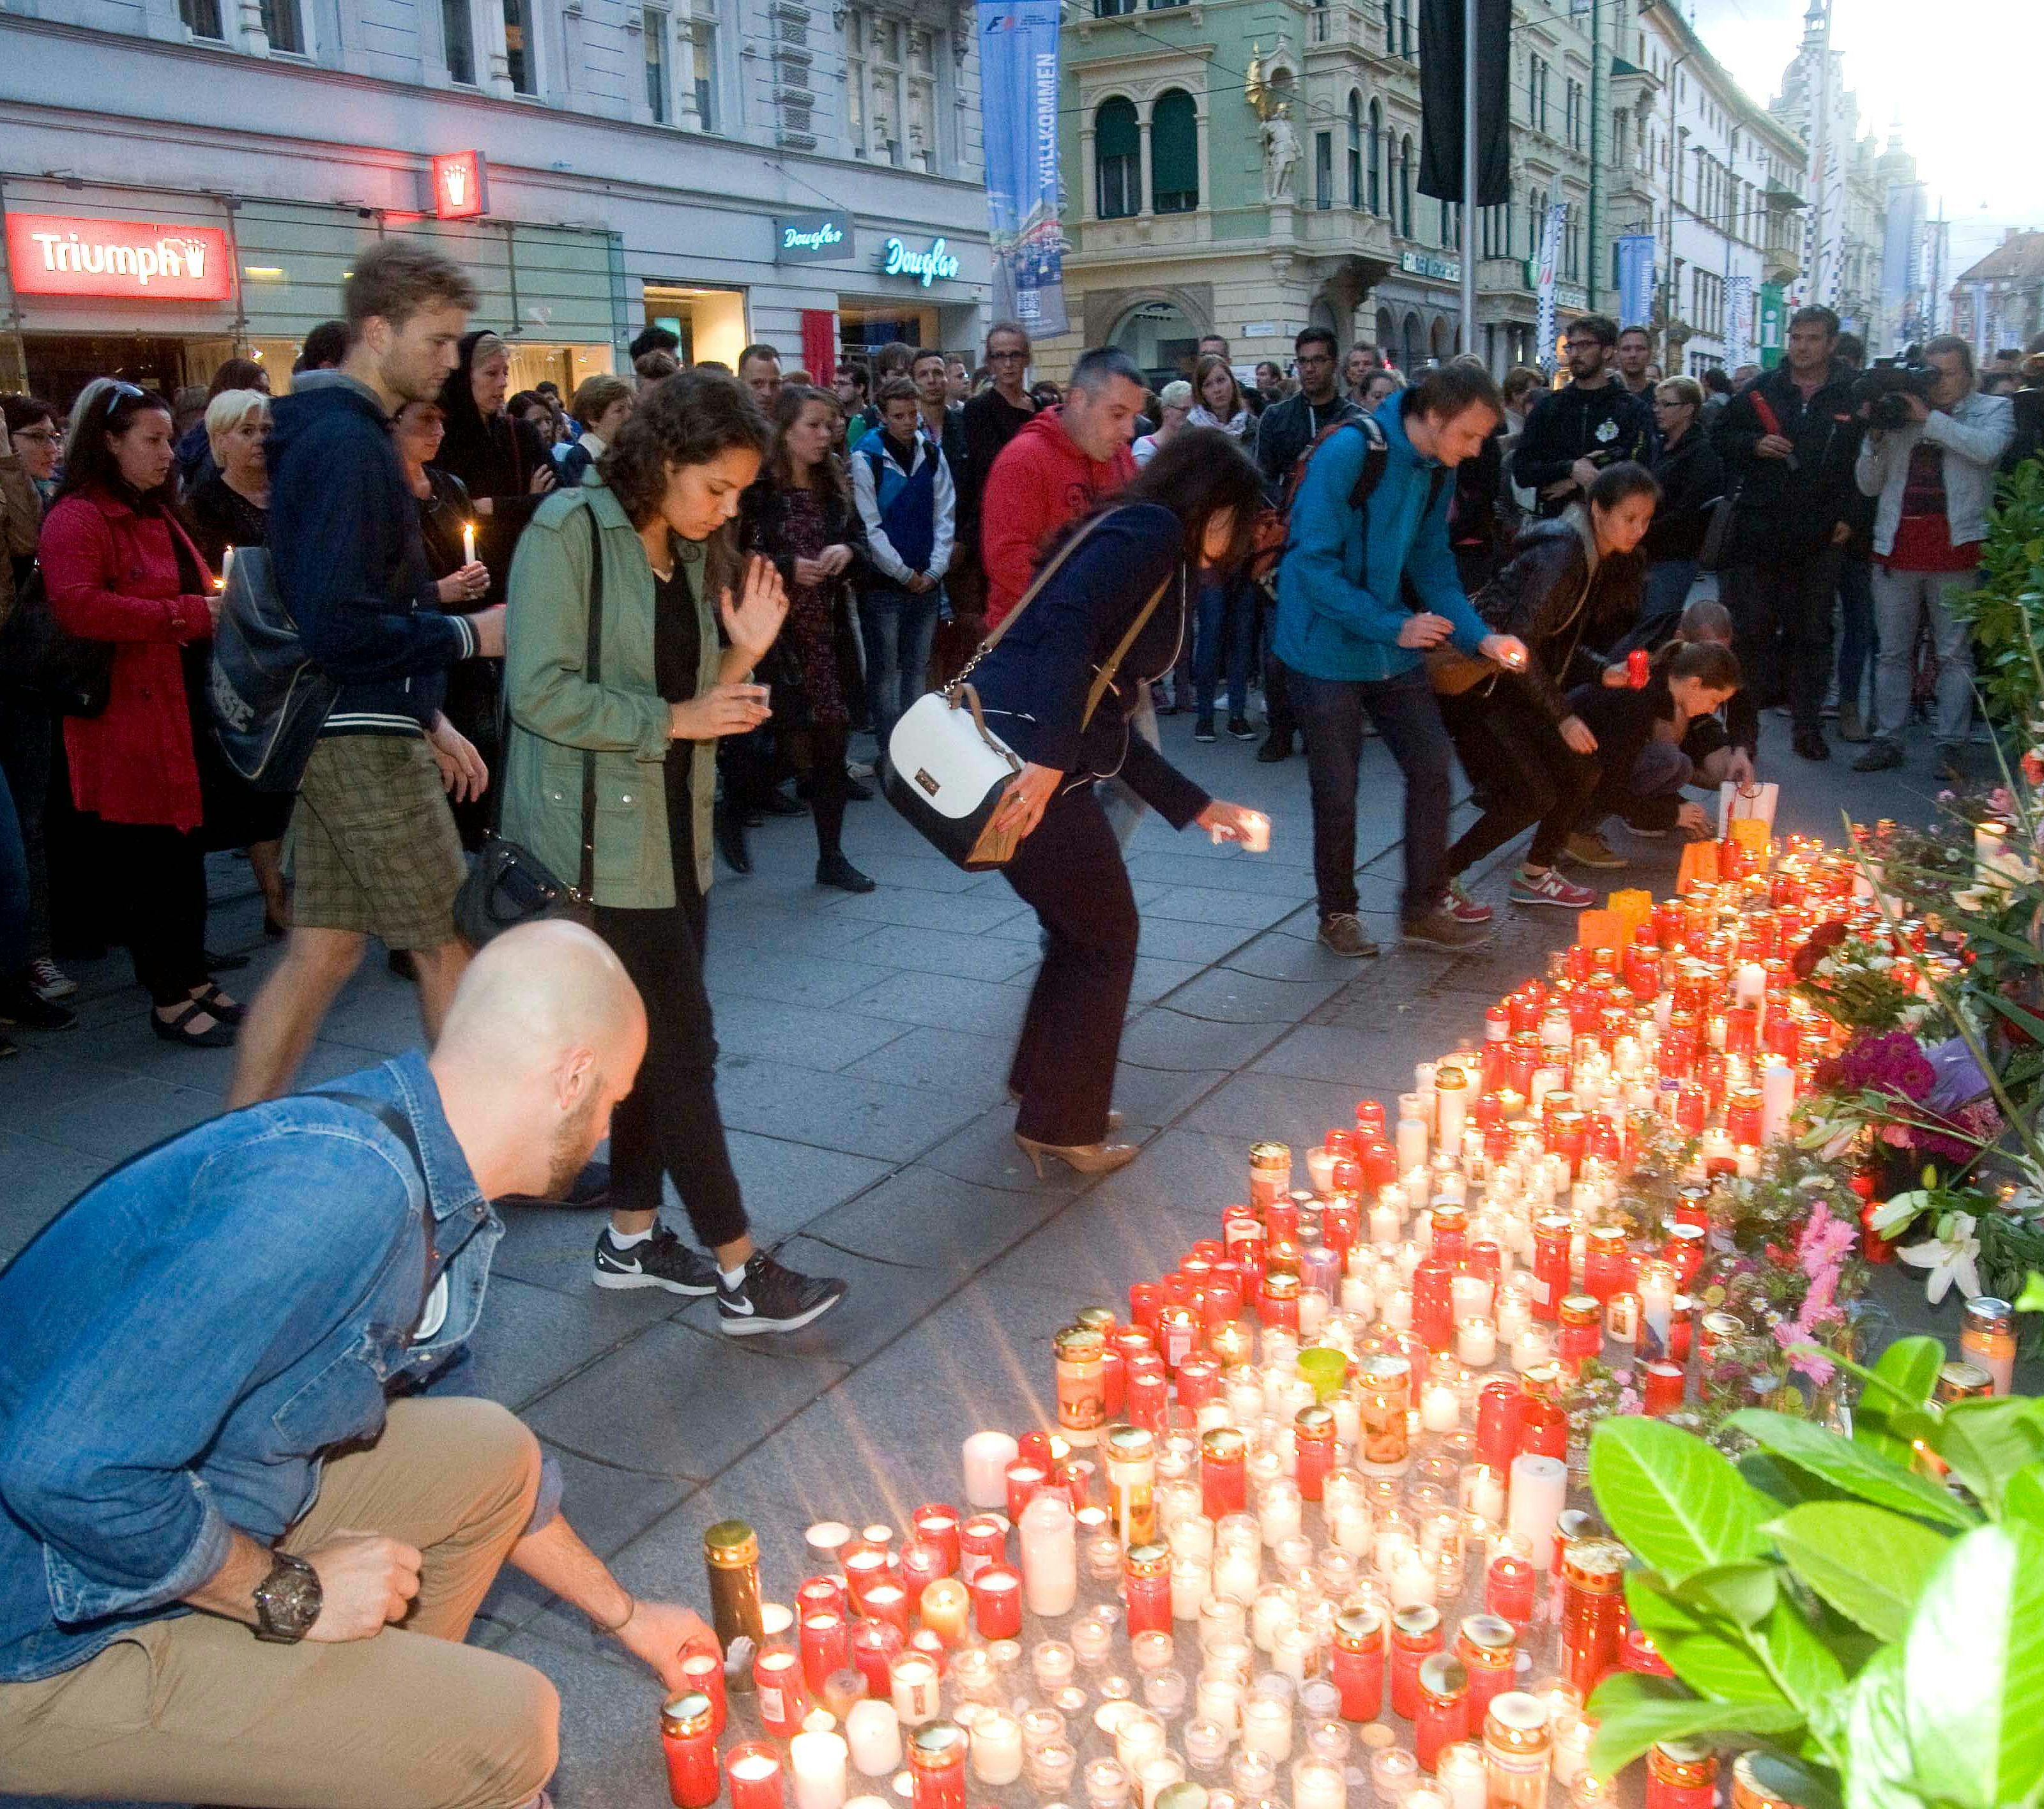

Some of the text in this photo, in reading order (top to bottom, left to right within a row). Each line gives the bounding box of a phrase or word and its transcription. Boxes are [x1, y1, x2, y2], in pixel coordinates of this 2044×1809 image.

[1037, 53, 1055, 189] WILLKOMMEN
[32, 233, 182, 286] Triumph
[784, 223, 843, 250] Douglas
[886, 238, 958, 287] Douglas
[1640, 260, 1652, 317] WILLKOMMEN
